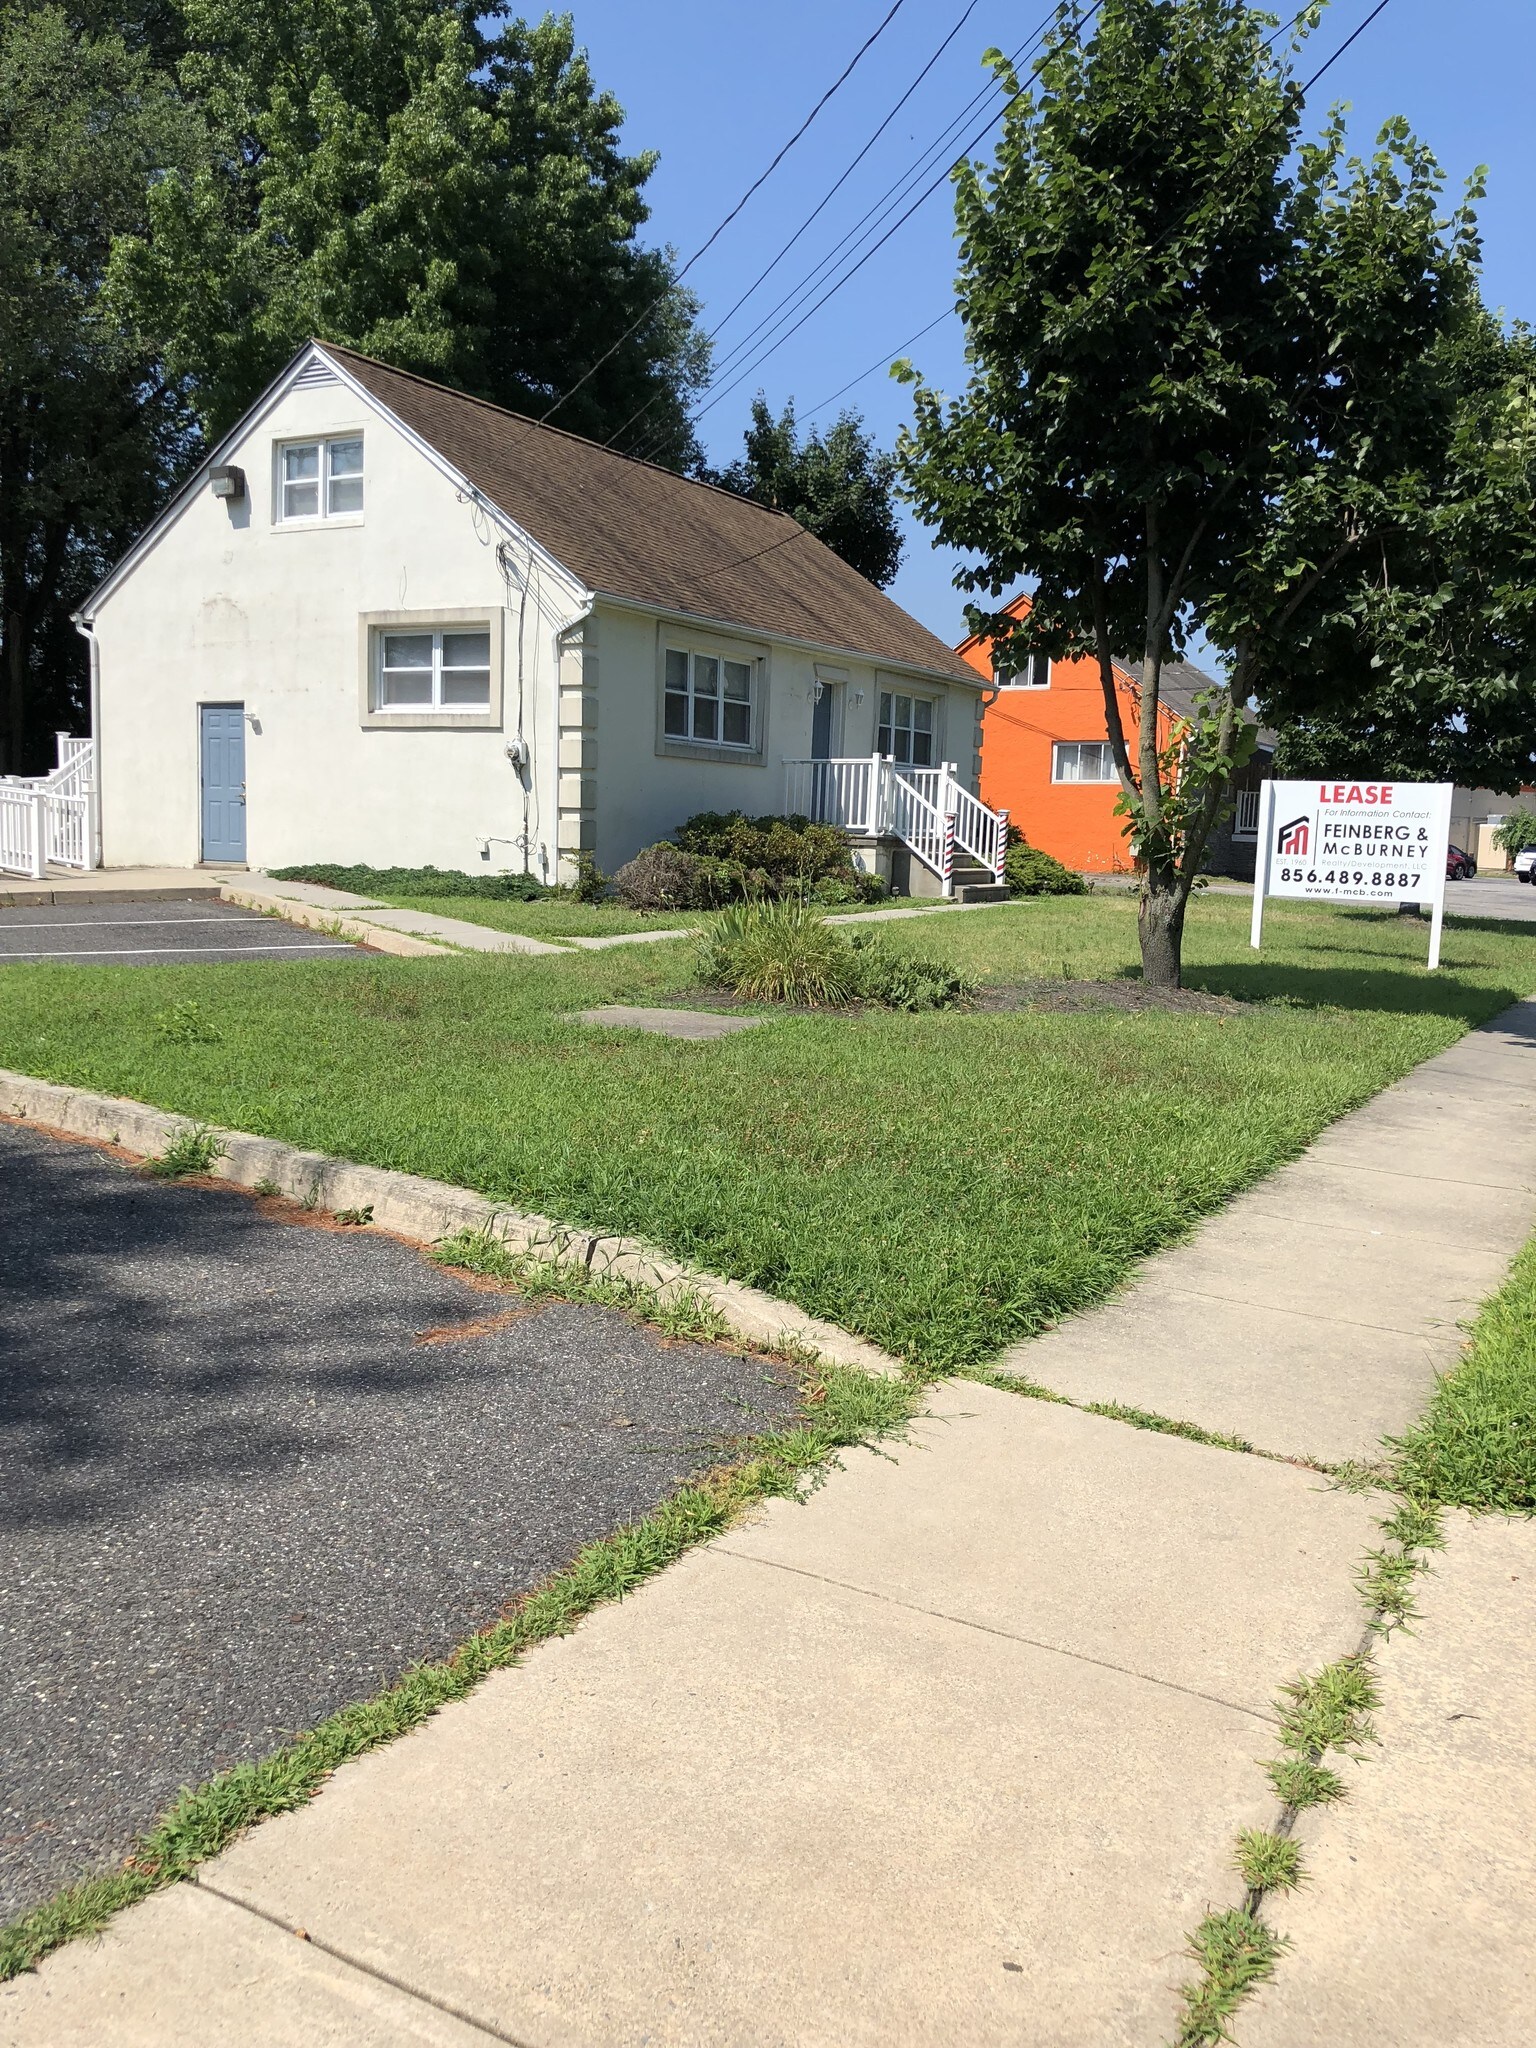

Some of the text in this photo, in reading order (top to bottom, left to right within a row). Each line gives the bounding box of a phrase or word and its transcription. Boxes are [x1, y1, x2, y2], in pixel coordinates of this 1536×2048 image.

[1319, 785, 1393, 804] LEASE
[1340, 809, 1389, 818] Information
[1392, 811, 1432, 819] Contact:
[1324, 824, 1428, 840] FEINBERG &
[1323, 843, 1428, 858] McBURNEY
[1281, 868, 1421, 888] 856.489.8887
[1305, 887, 1393, 897] www.f-mcb.com
